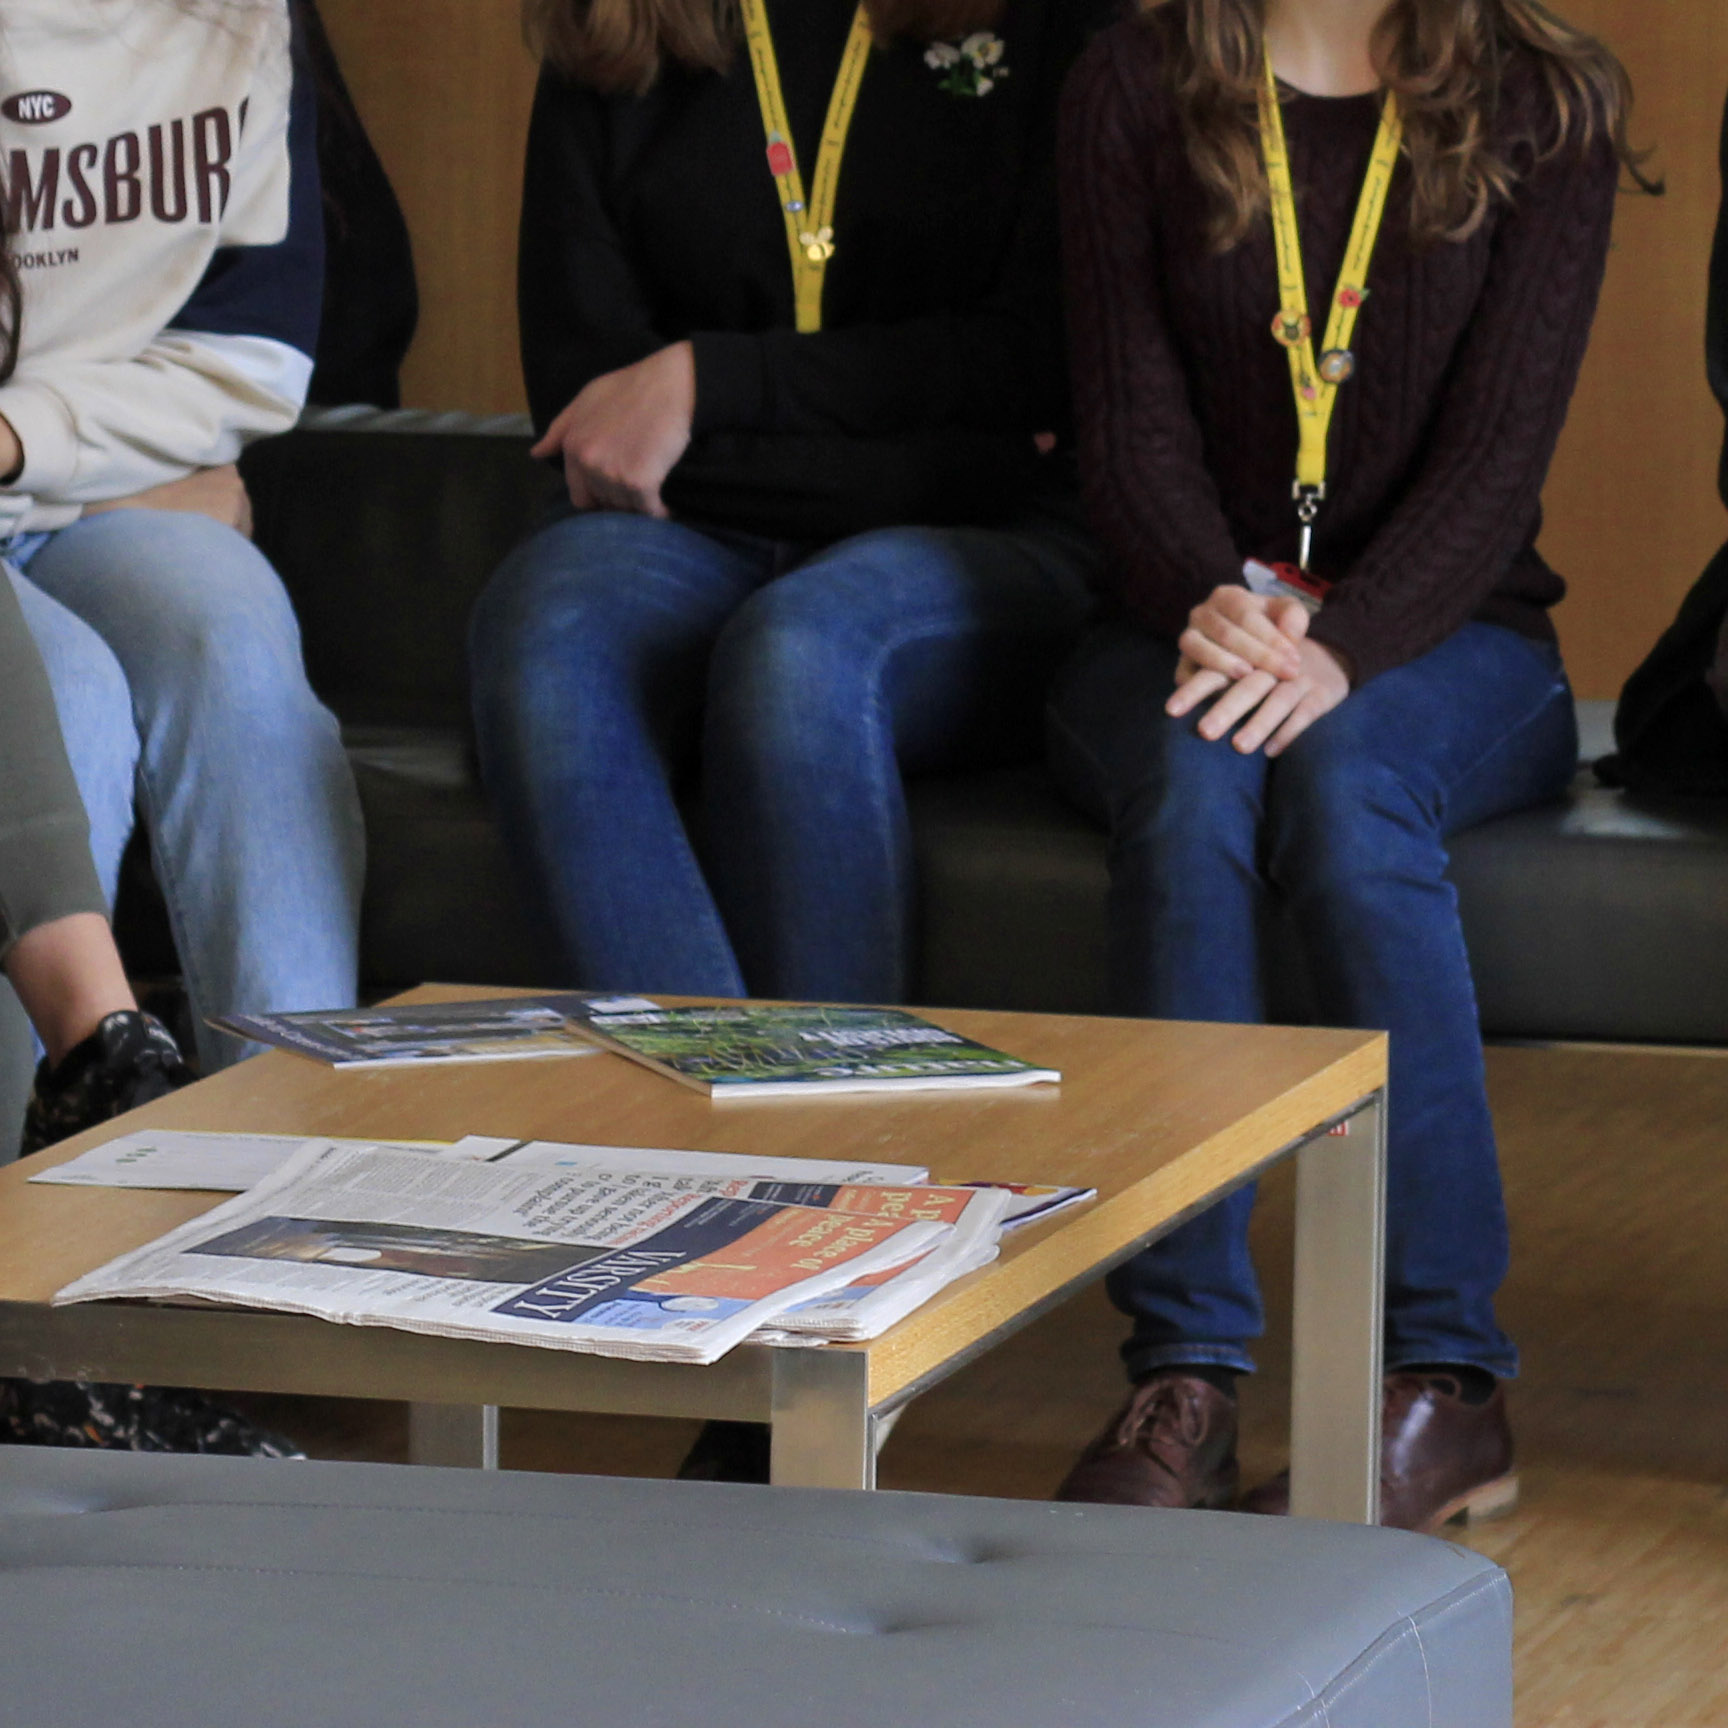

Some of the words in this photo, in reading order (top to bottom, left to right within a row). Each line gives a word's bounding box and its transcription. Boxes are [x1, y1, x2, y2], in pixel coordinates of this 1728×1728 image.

[18, 93, 56, 119] NYC
[7, 95, 250, 234] MSBUR
[788, 1213, 856, 1247] peace
[863, 1217, 896, 1228] A
[813, 1226, 876, 1258] place
[790, 1257, 824, 1271] of
[513, 1250, 687, 1319] VARSITY
